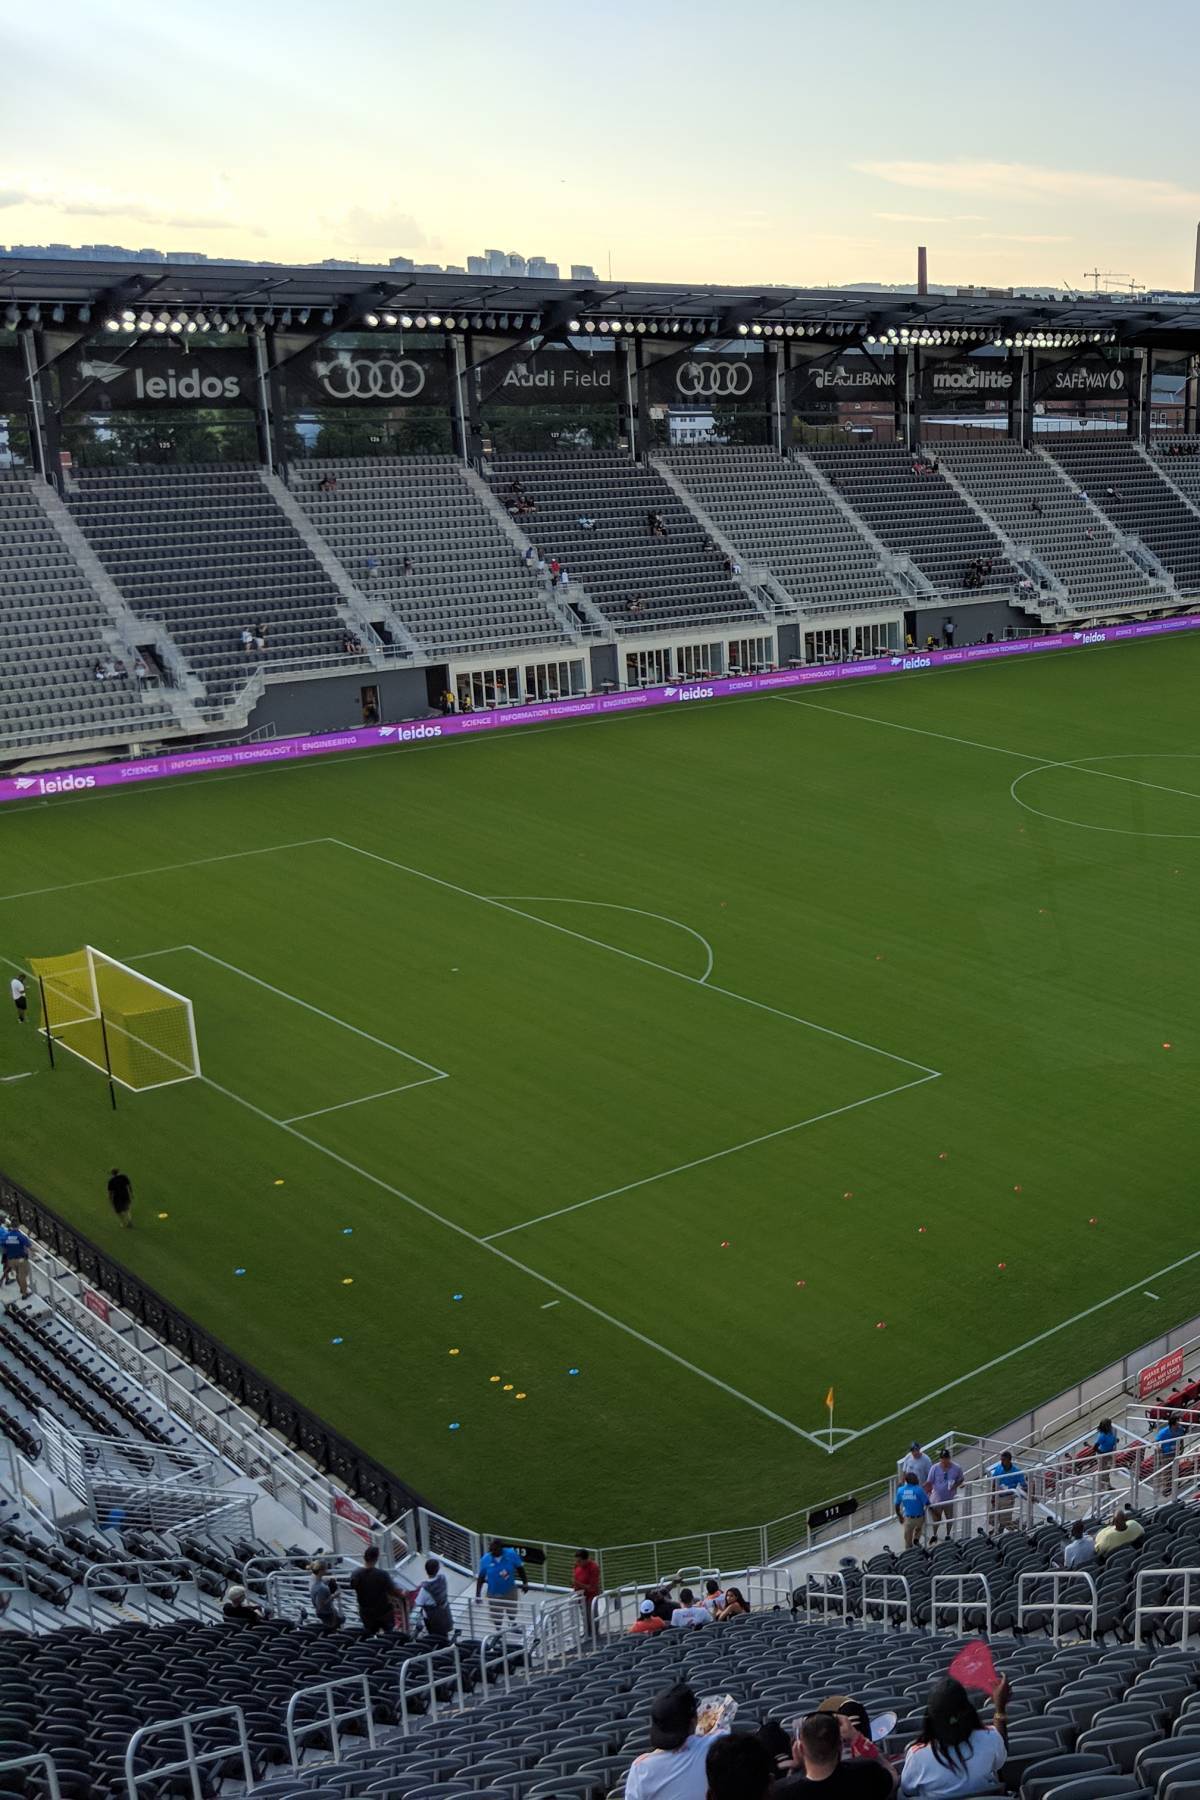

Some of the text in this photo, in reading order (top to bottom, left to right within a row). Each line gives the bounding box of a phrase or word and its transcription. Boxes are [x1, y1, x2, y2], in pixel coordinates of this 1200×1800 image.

[134, 368, 241, 399] leidos
[503, 369, 612, 387] Audi Field
[933, 371, 1013, 388] mobilitie
[1055, 372, 1110, 389] SAFEWAY
[1082, 631, 1106, 644] leidos
[903, 656, 931, 670] leidos
[679, 686, 714, 701] leidos
[398, 695, 647, 741] leidos SCIENCE INFORMATION TECHNOLOGY ENGINEERING
[39, 735, 357, 794] leidos SCIENCE INFORMATION TECHNOLOGY ENGINEERING
[824, 1506, 840, 1518] 111
